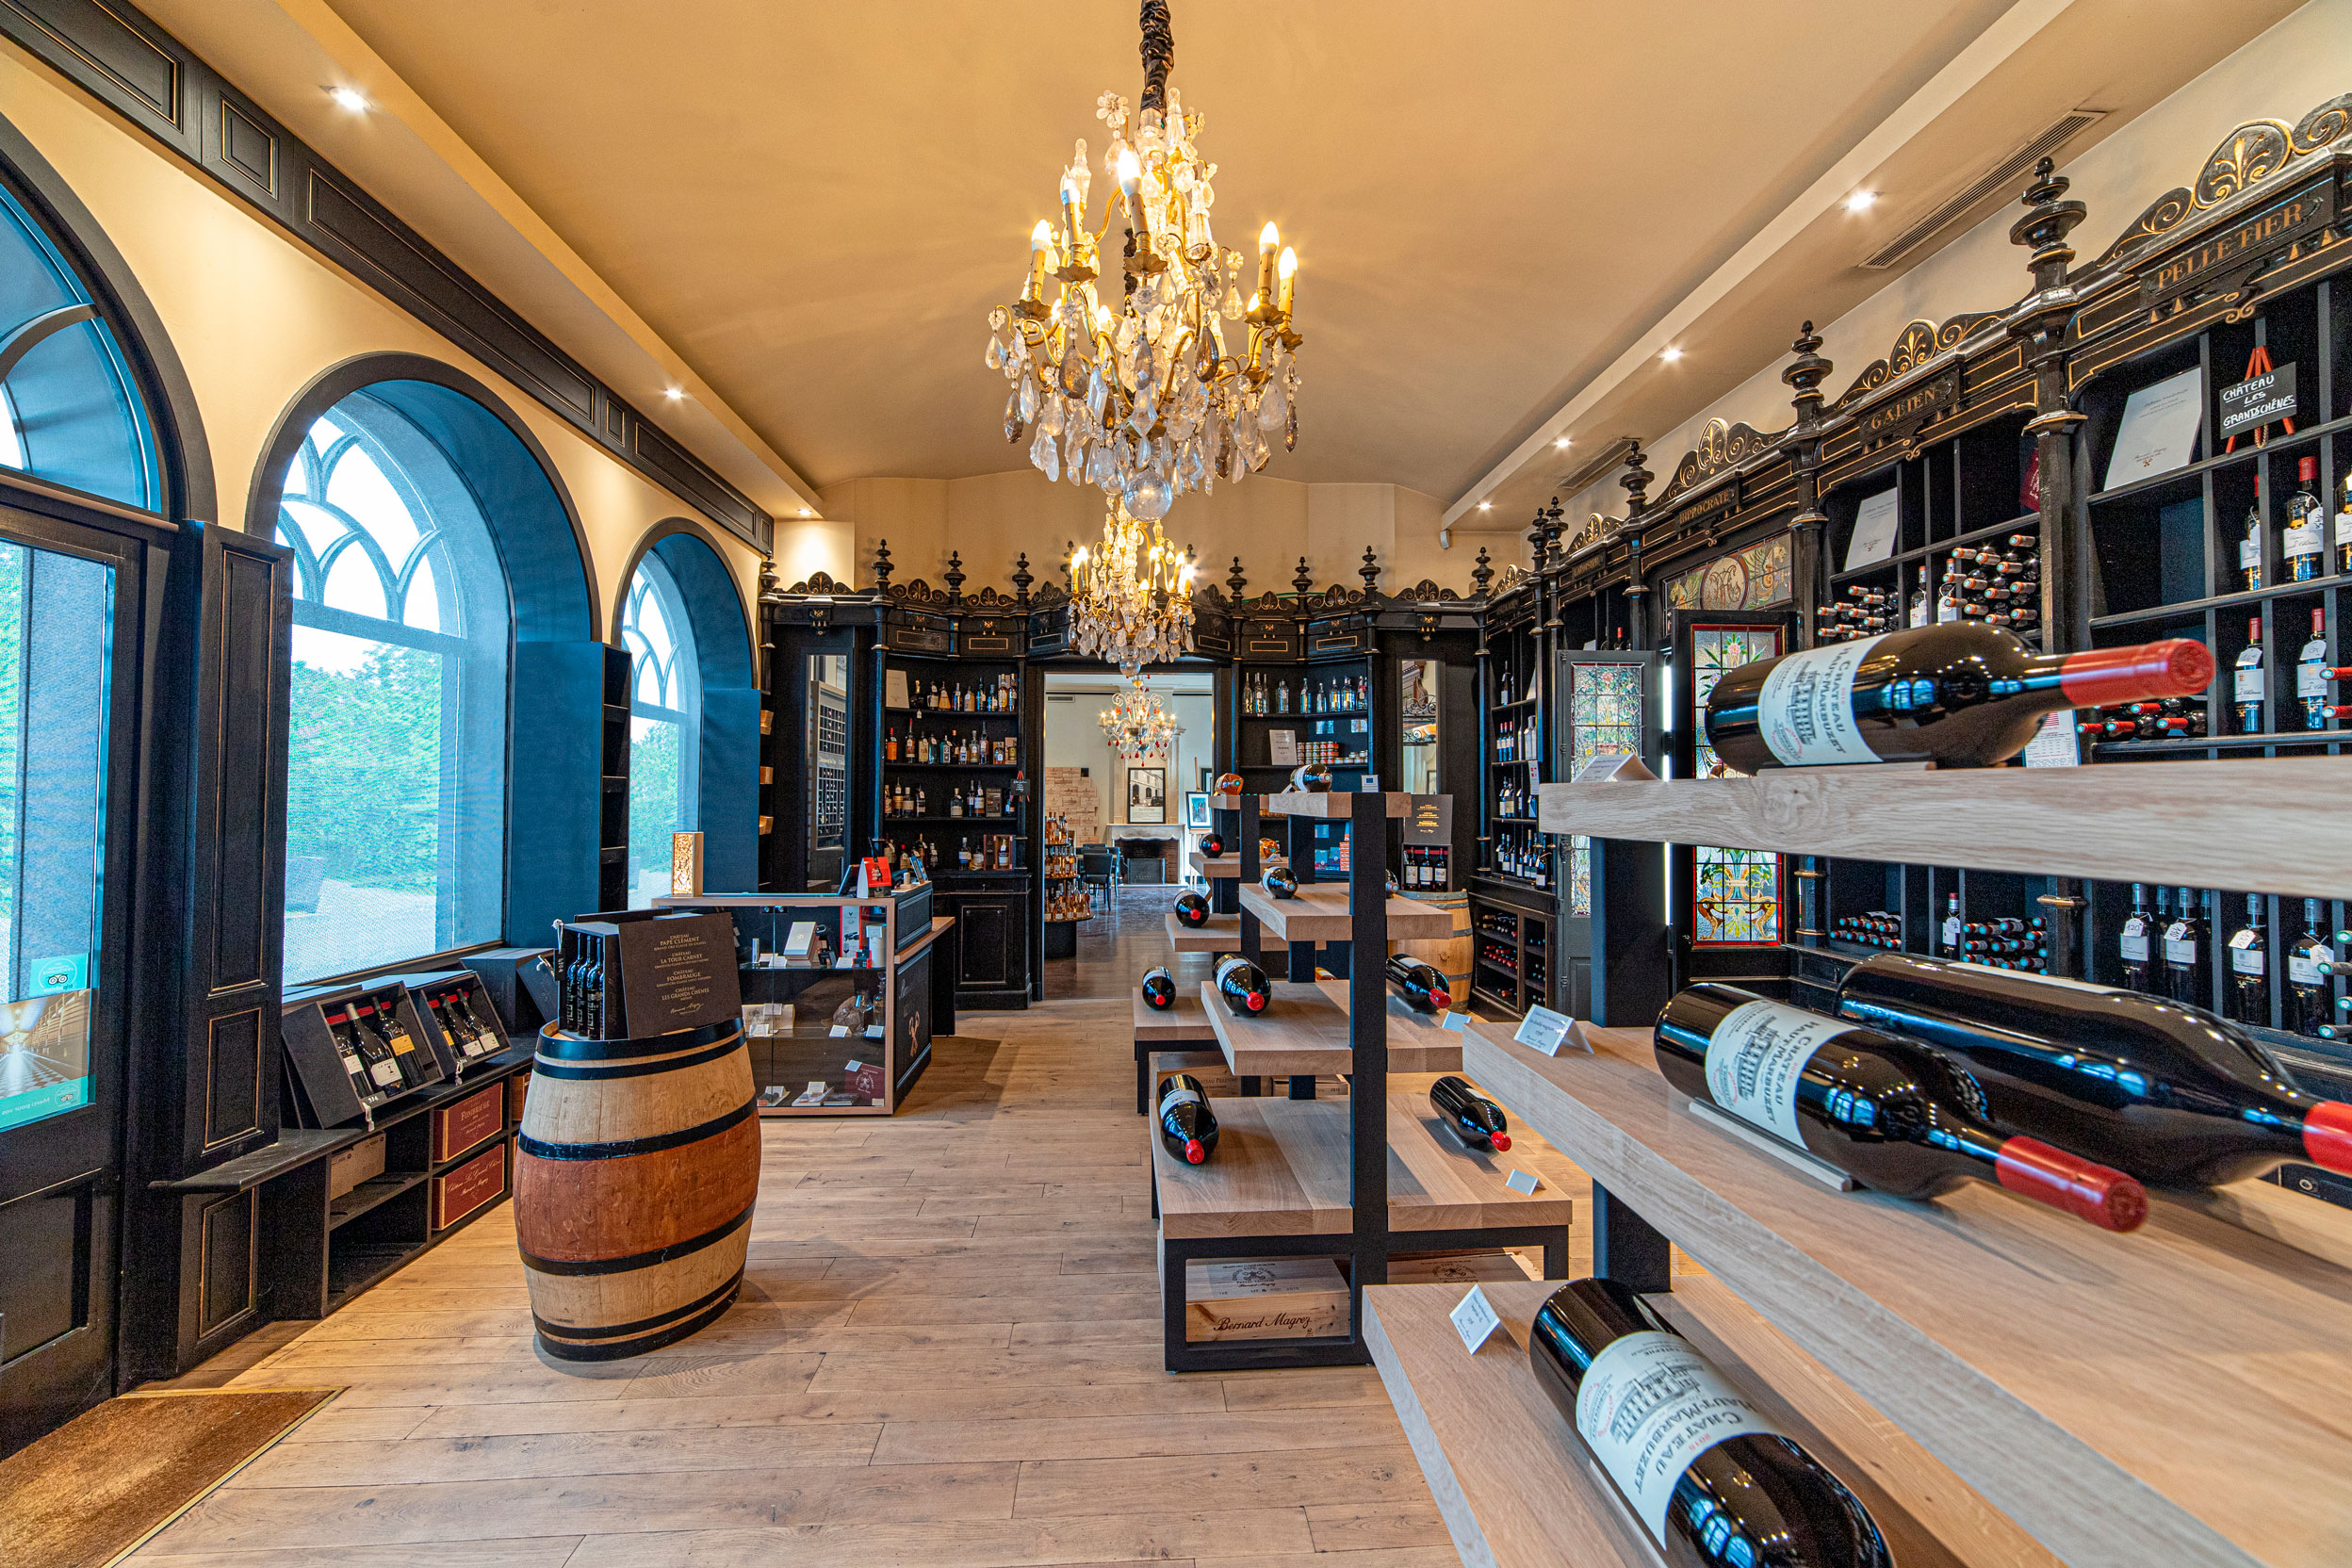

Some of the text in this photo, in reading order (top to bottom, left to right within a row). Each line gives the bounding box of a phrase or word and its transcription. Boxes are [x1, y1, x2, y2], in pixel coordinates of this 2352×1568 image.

[2157, 203, 2305, 290] PELLETIER
[1870, 384, 1938, 430] GALIEN
[2222, 374, 2275, 402] CHÂTEAU
[2244, 391, 2267, 406] LES
[1677, 491, 1732, 525] HIPPOCRATE
[1819, 647, 1854, 754] HAUT-MARBUZET
[1833, 661, 1851, 732] CHATEAU
[674, 936, 700, 945] CLÉMENT
[683, 953, 703, 961] CARNET
[670, 991, 691, 1000] GRANDS
[691, 987, 710, 996] CHÊNES
[1762, 1021, 1820, 1126] HAUT-MARBUZET
[1775, 1037, 1812, 1105] CHATEAU
[1213, 1311, 1312, 1332] Bernard Magrez
[1634, 1400, 1759, 1495] HAUT-MARBUZET
[1654, 1411, 1742, 1477] CHATEAU
